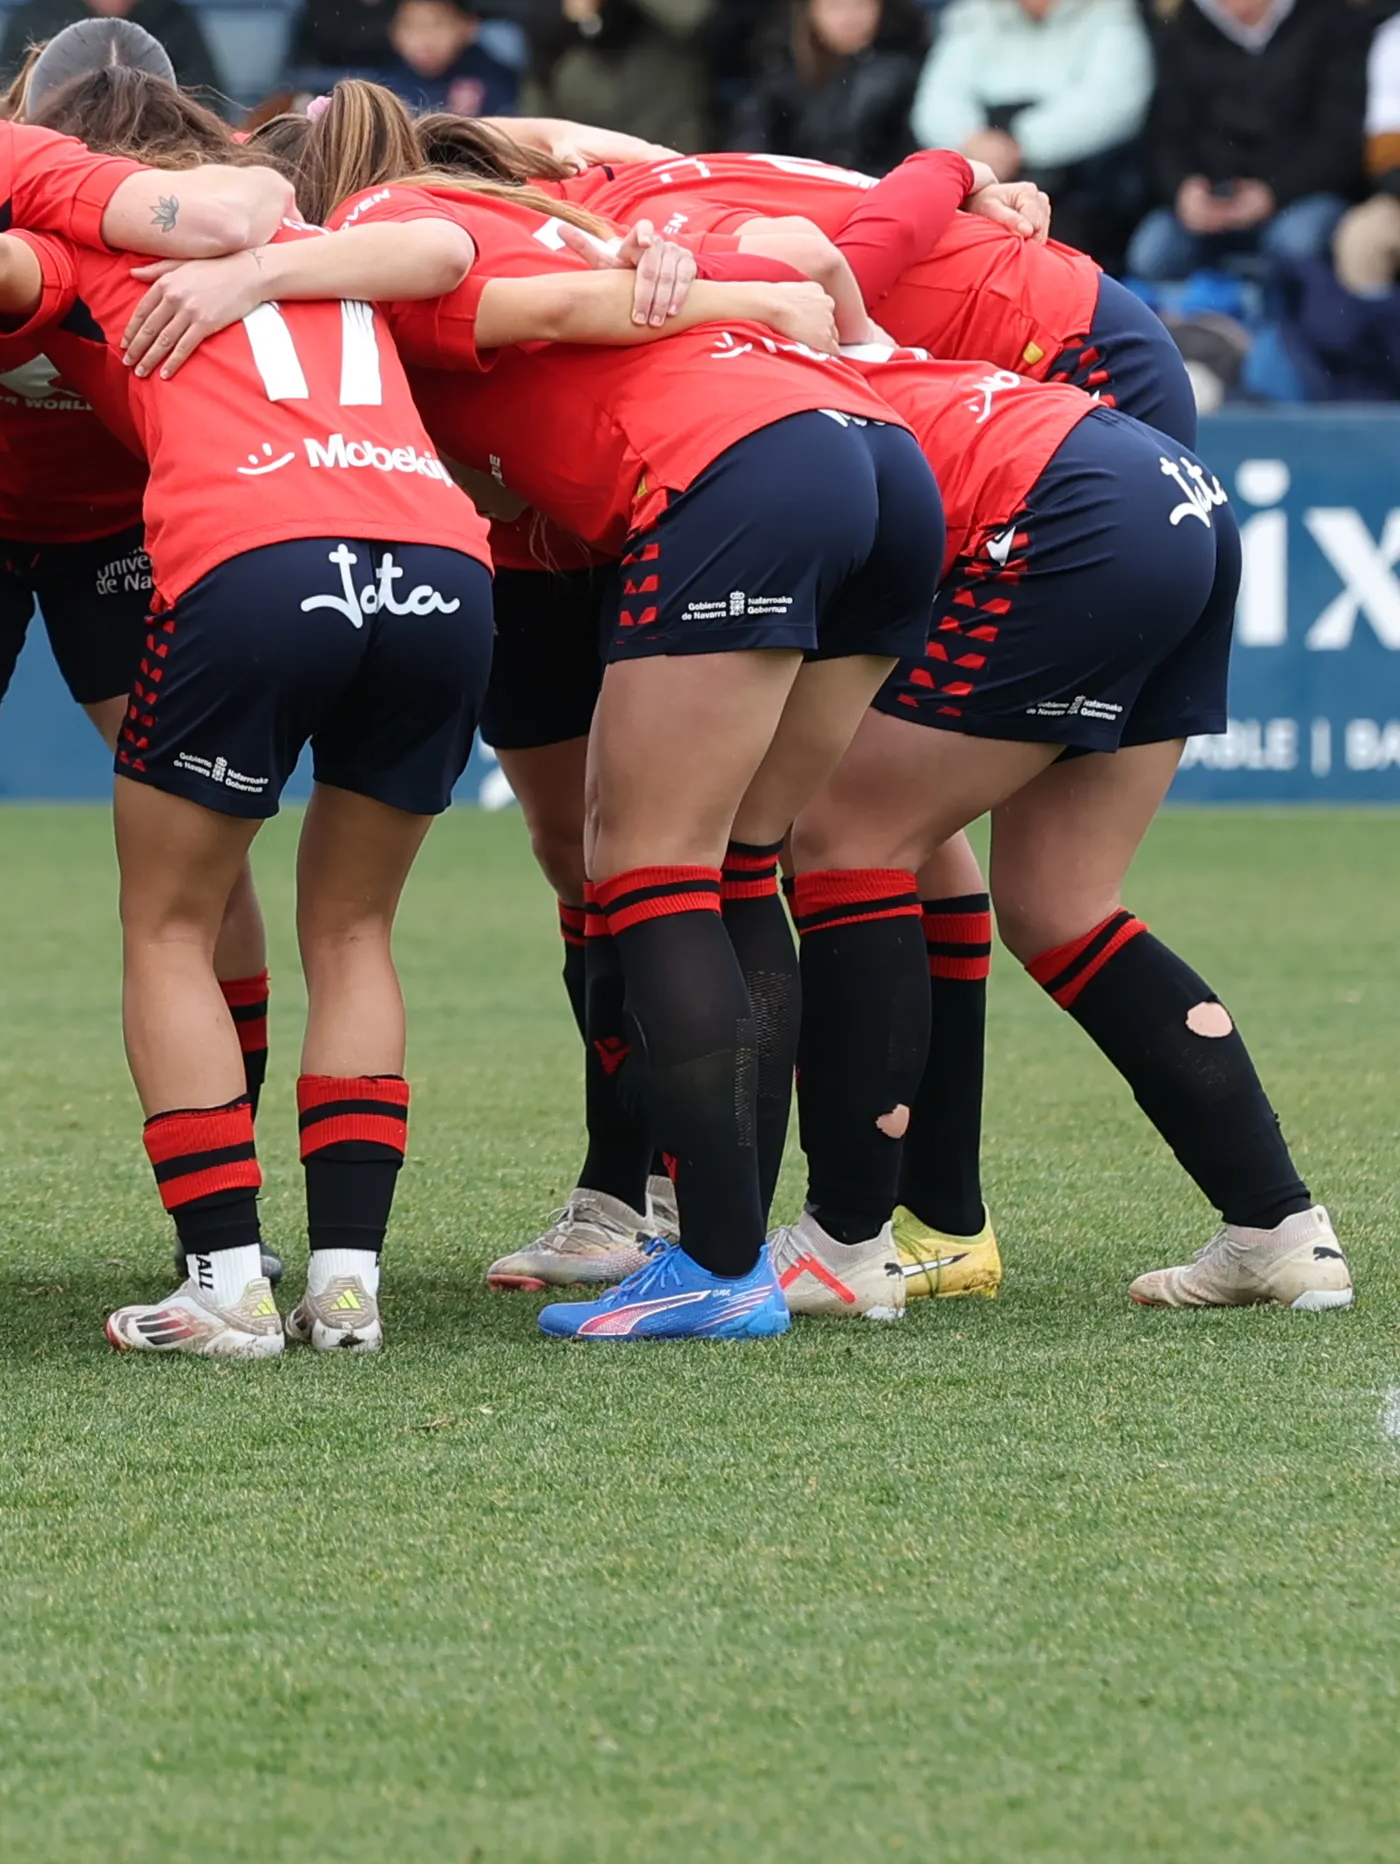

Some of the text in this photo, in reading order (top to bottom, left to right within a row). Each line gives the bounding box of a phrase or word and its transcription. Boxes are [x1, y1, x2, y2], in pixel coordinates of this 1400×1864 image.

[688, 601, 727, 611] Gobierno
[681, 610, 727, 621] de Navarra
[180, 752, 212, 768] Gobierno
[197, 1254, 214, 1290] ALL
